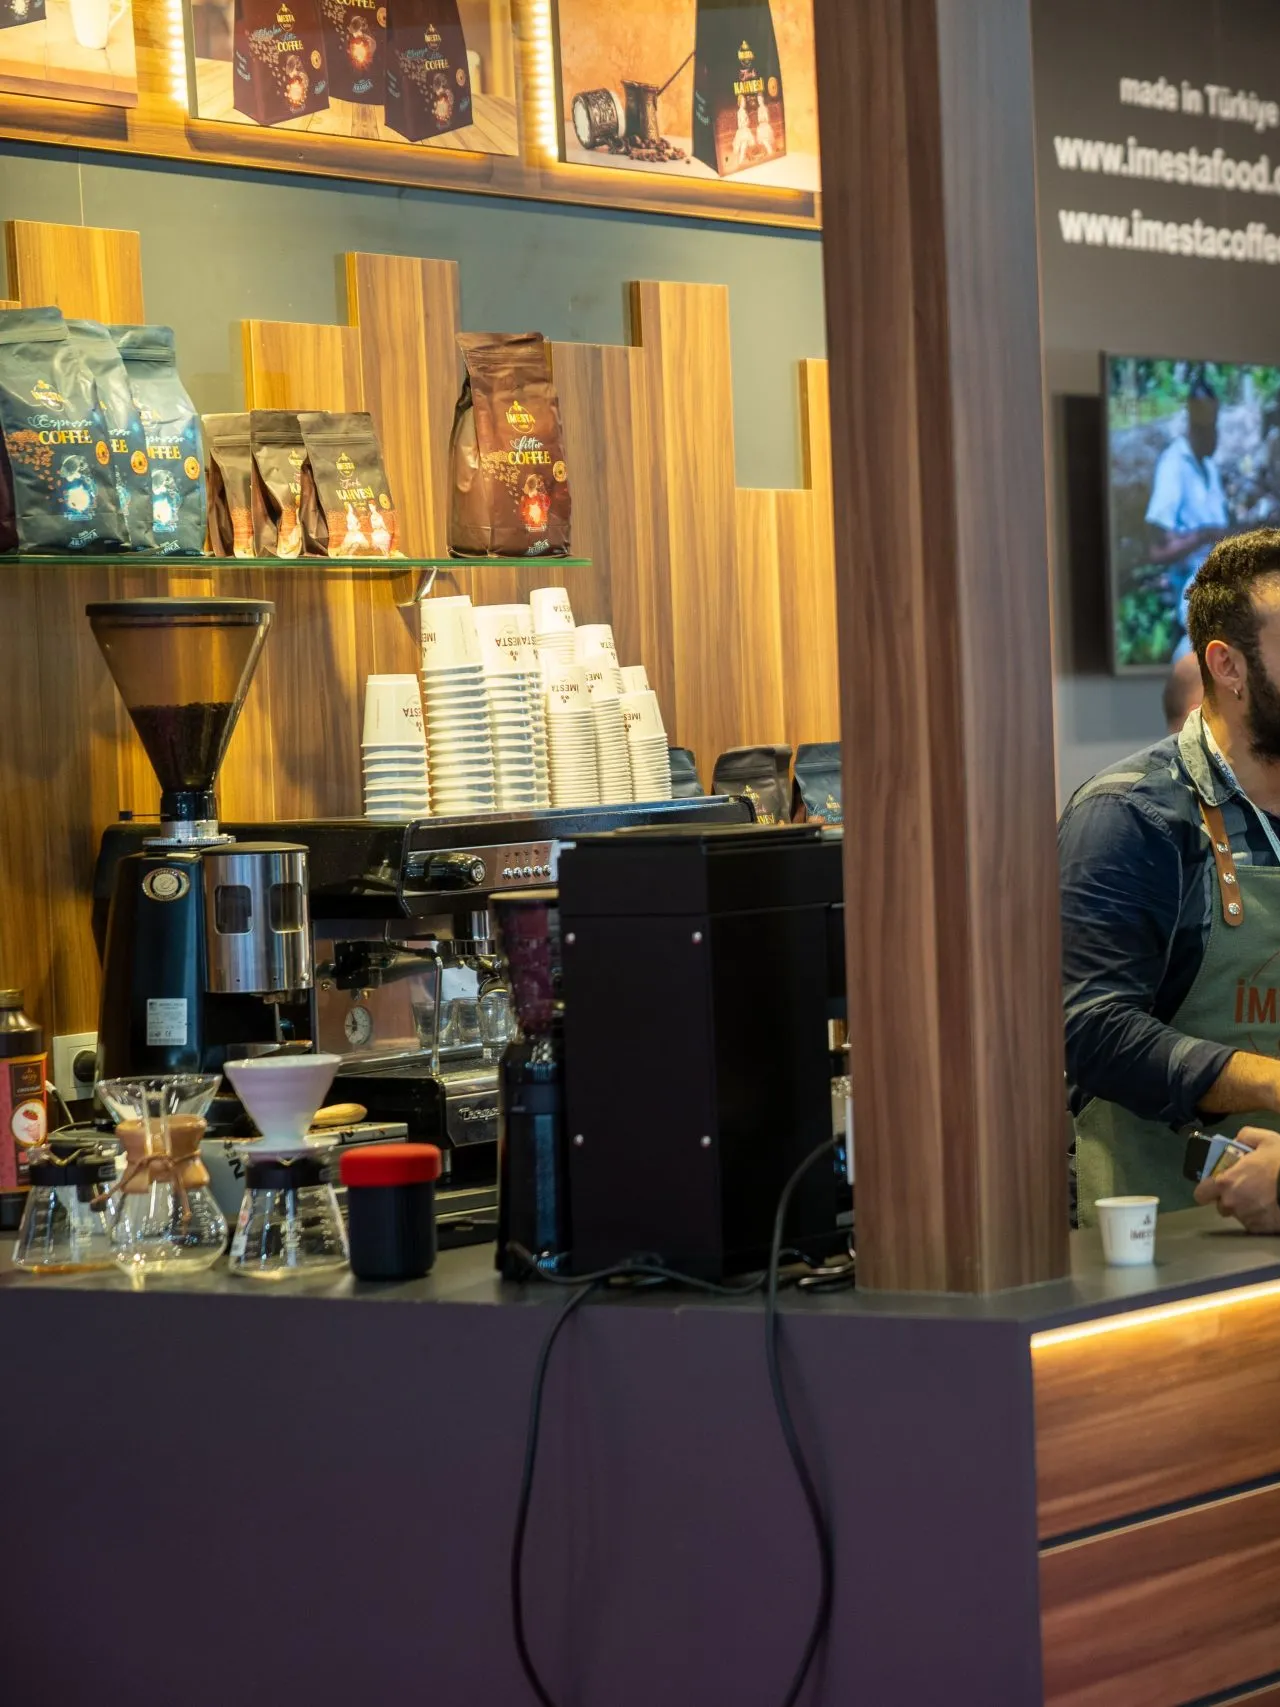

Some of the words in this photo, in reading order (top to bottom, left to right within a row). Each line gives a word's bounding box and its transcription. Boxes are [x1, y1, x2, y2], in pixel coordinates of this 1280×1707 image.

[1120, 76, 1179, 111] made
[1181, 81, 1203, 114] in
[1205, 84, 1280, 133] Türkiye
[38, 429, 93, 445] COFFEE
[508, 450, 551, 465] COFFEE
